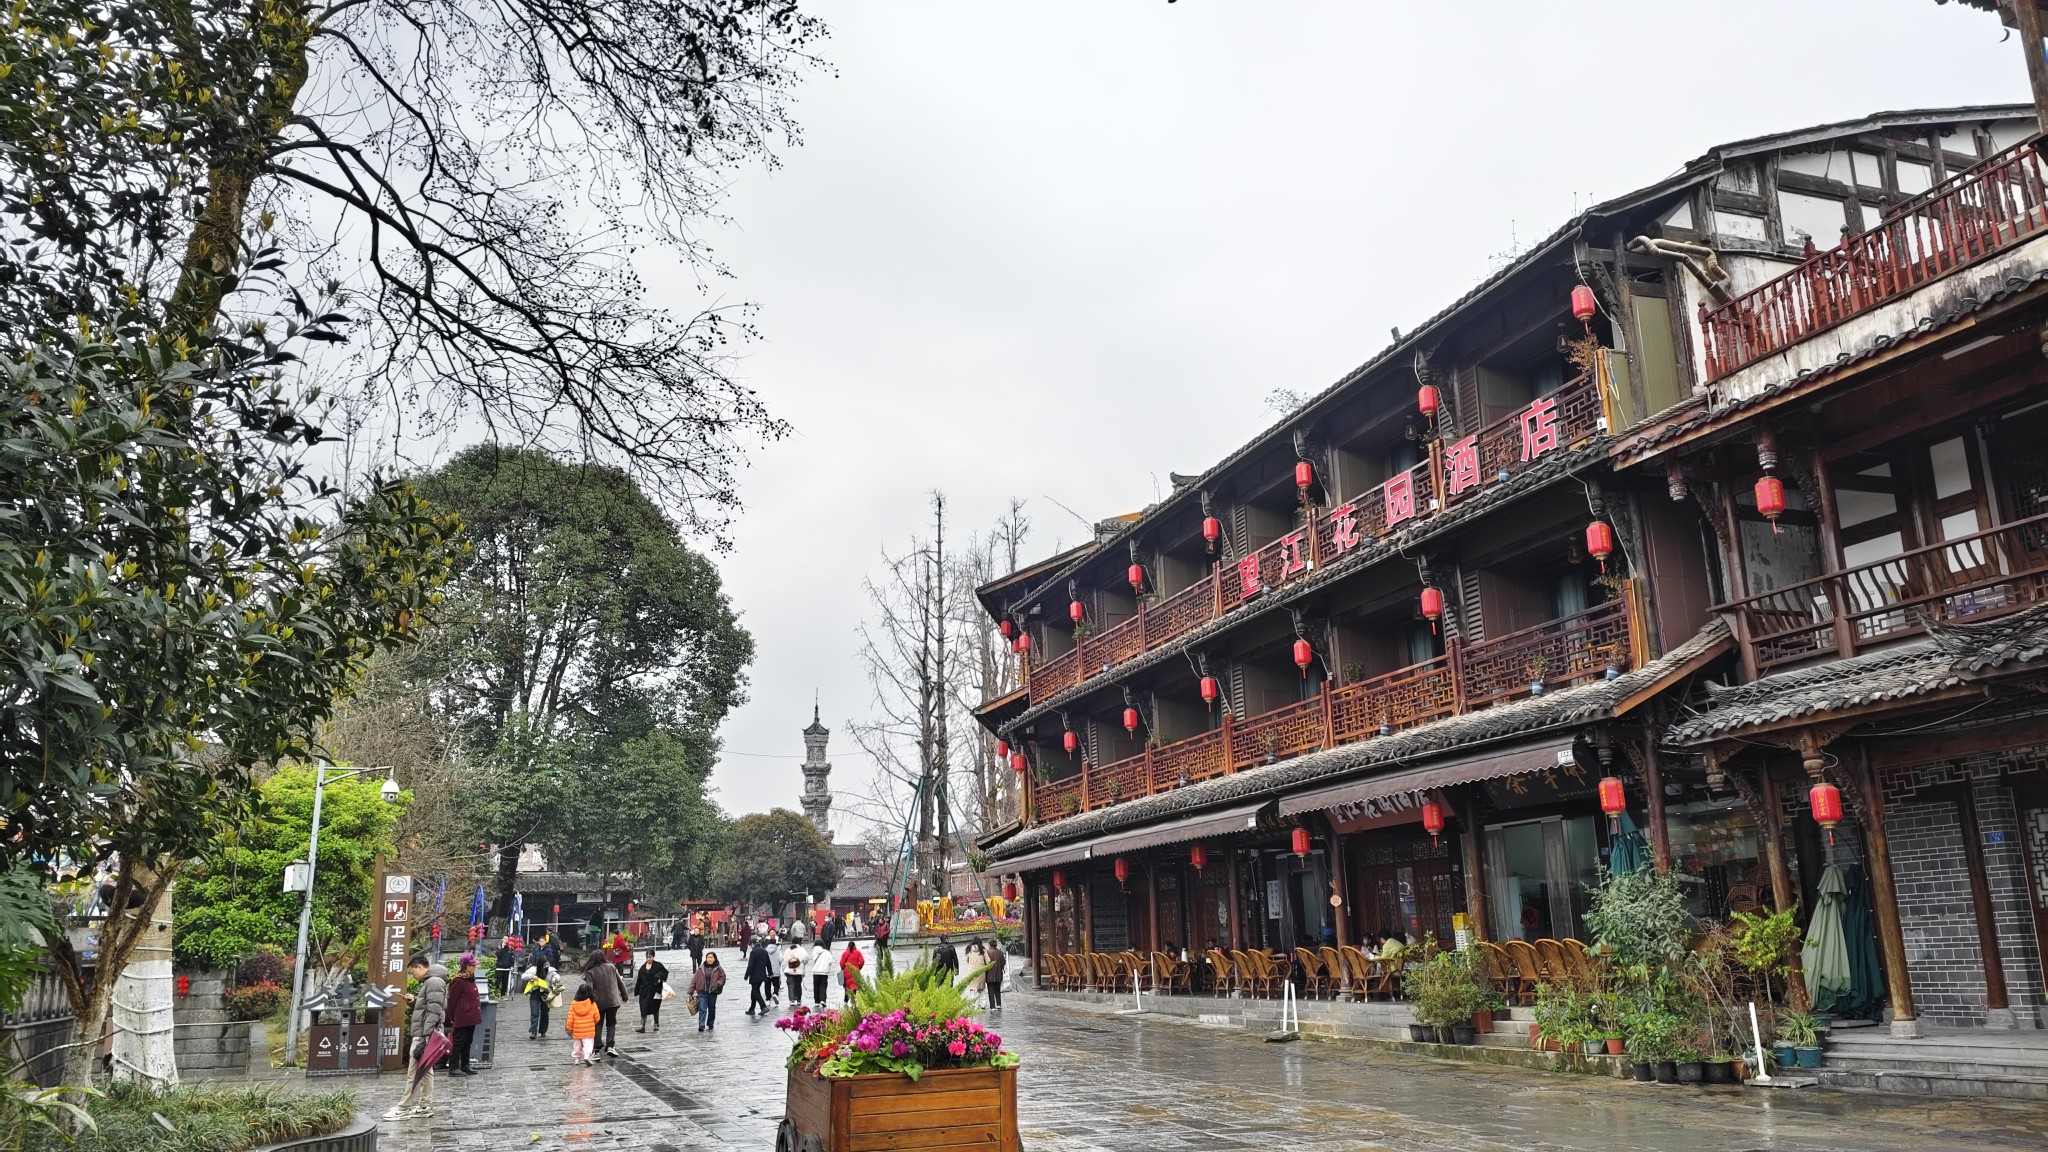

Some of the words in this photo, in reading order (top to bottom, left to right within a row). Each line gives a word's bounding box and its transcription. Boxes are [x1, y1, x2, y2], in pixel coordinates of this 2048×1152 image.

[1238, 397, 1558, 600] 望江花园酒店
[389, 925, 406, 973] 卫生间
